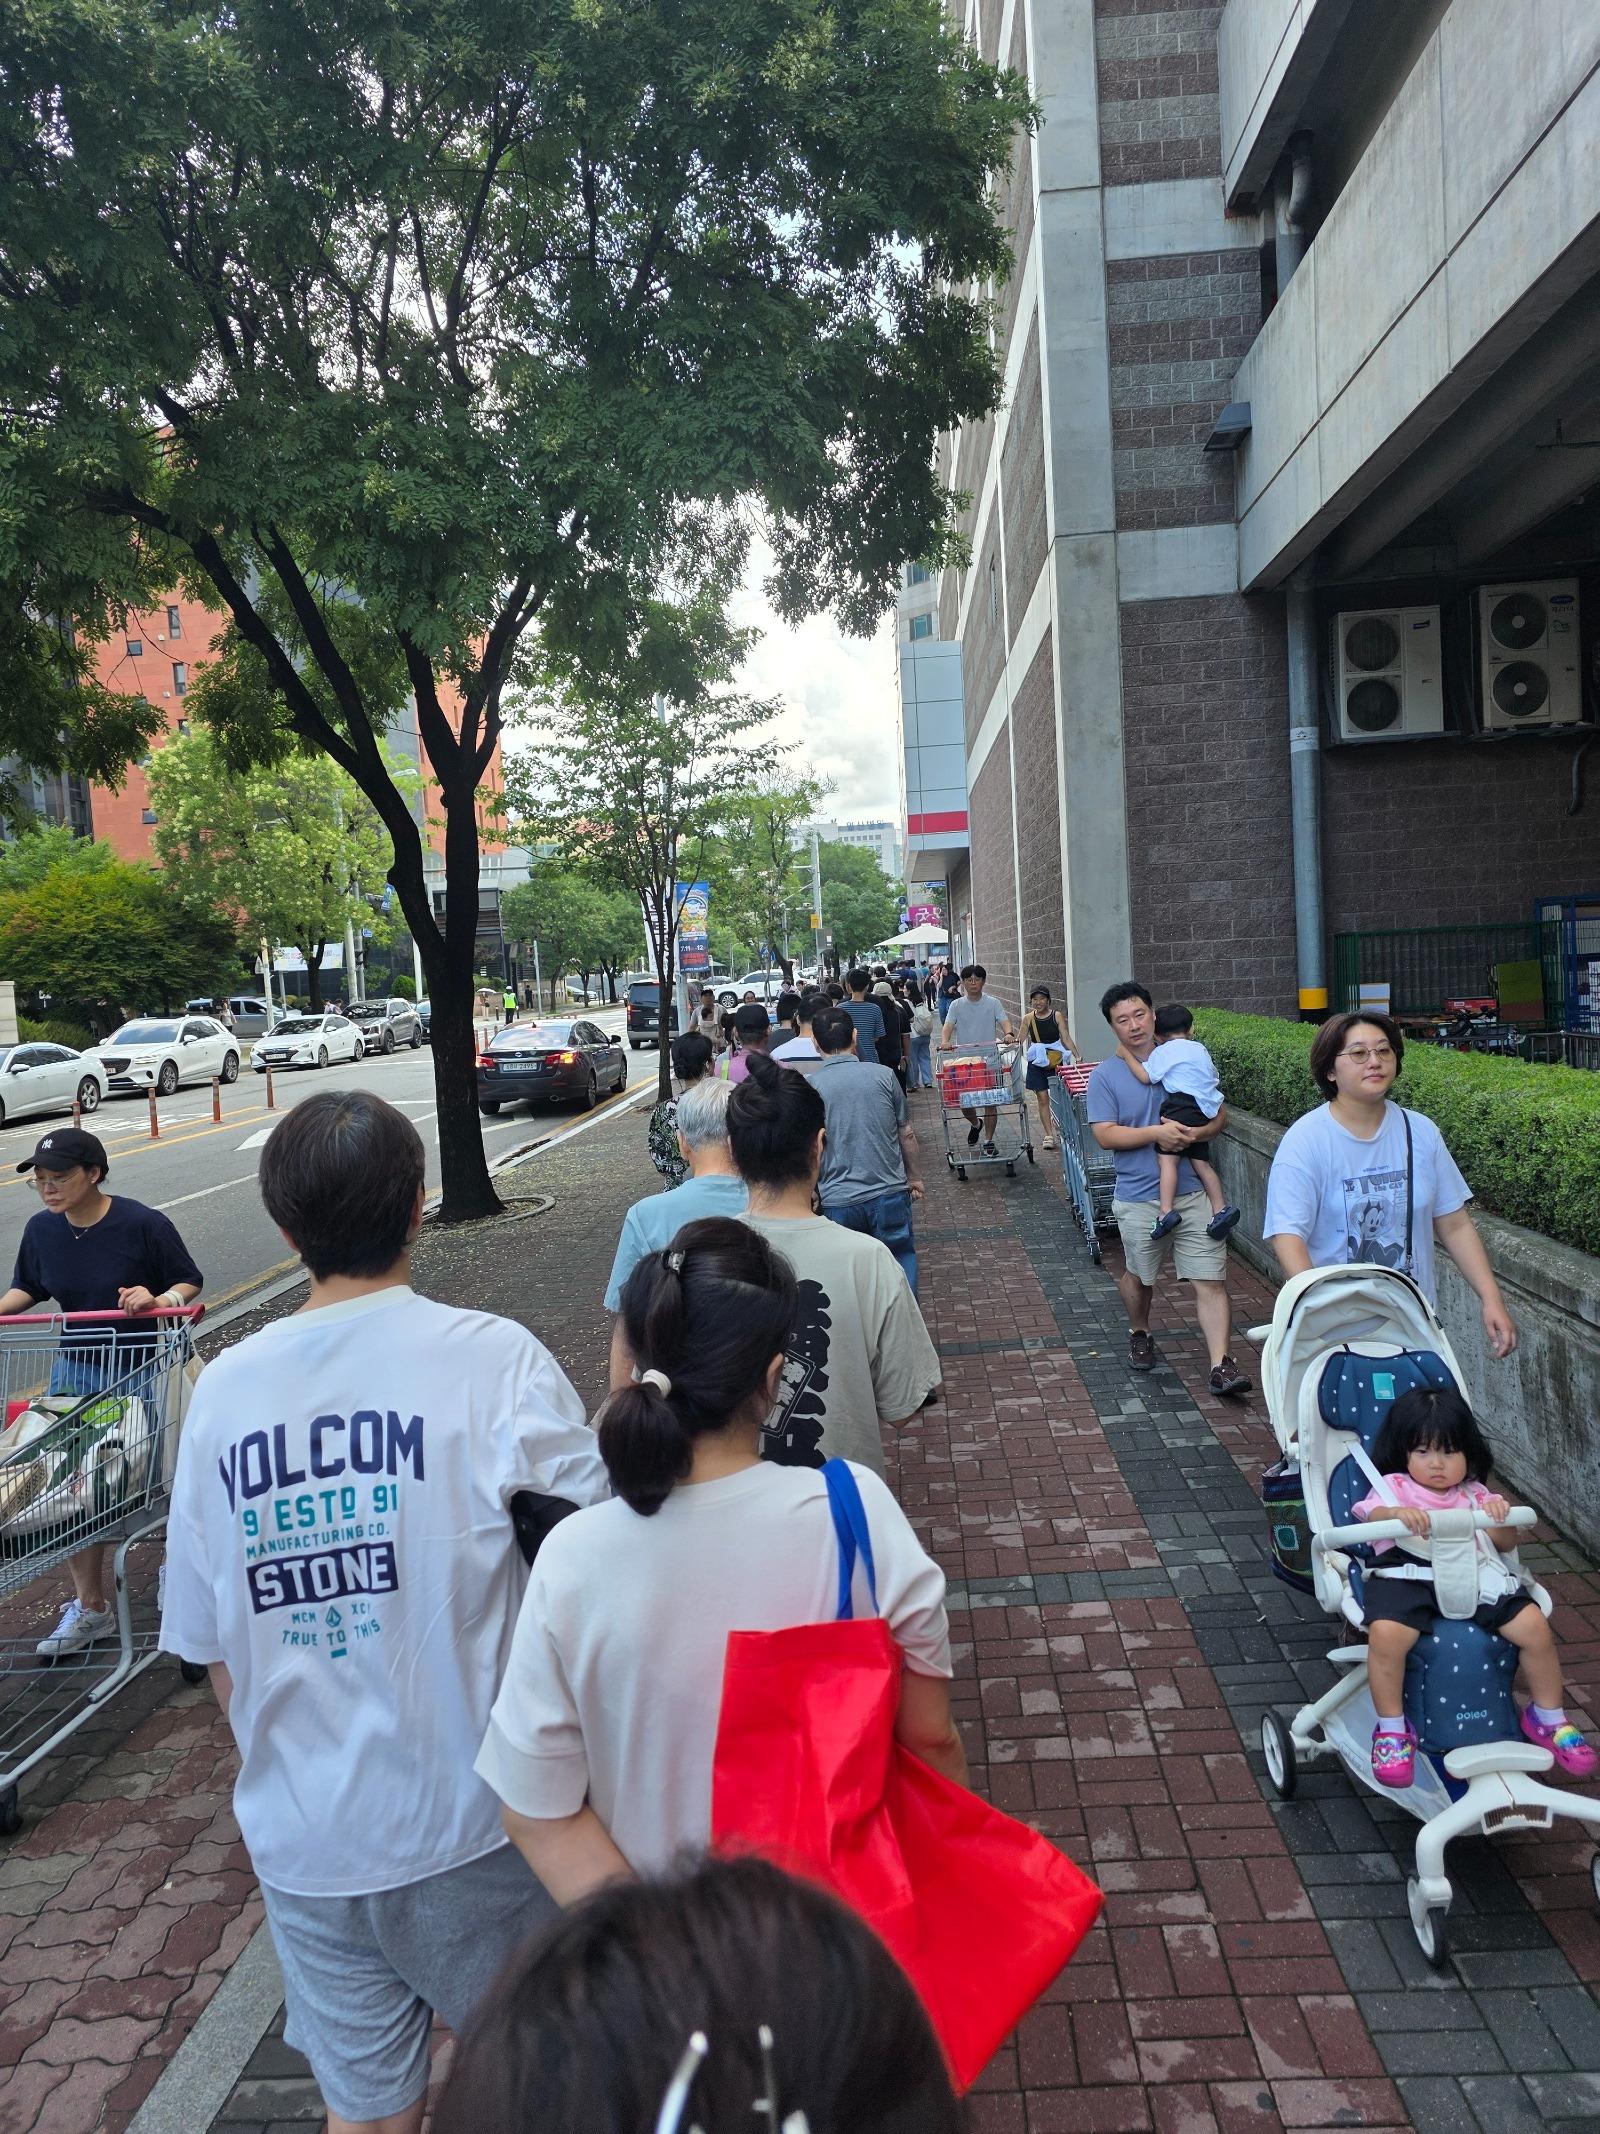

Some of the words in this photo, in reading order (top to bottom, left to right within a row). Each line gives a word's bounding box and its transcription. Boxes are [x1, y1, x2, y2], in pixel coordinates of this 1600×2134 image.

[218, 1409, 425, 1515] VOLCOM
[372, 1483, 398, 1514] 91
[246, 1524, 364, 1560] MANUFACTURING
[368, 1522, 390, 1537] CO.
[254, 1545, 392, 1608] STONE
[282, 1630, 318, 1647] TRUE
[326, 1629, 346, 1646] TO
[353, 1618, 381, 1639] THIS
[291, 1611, 317, 1624] MCM
